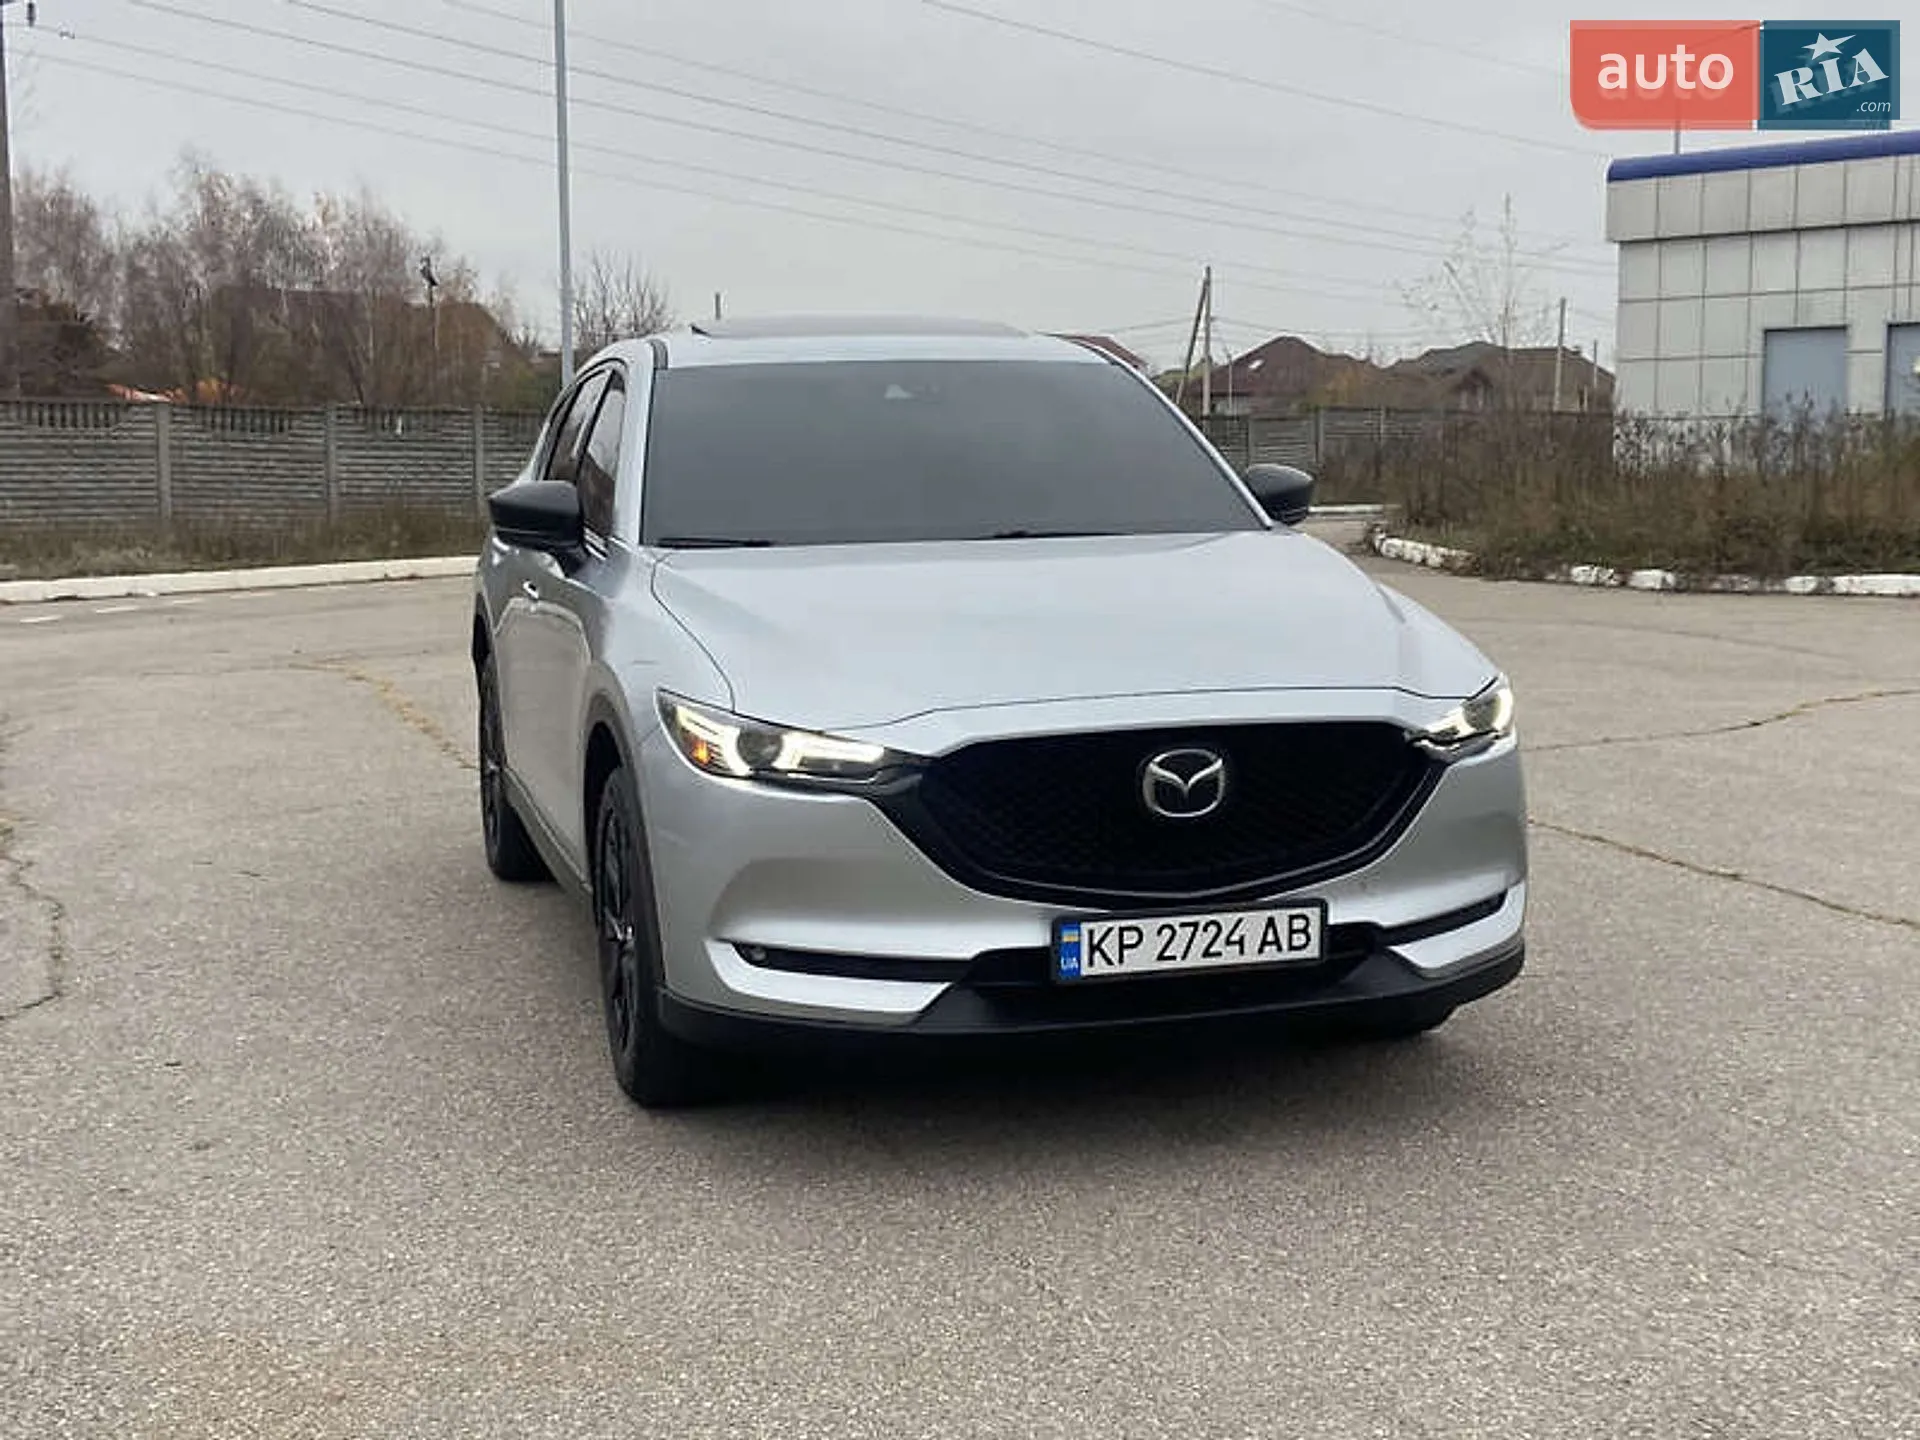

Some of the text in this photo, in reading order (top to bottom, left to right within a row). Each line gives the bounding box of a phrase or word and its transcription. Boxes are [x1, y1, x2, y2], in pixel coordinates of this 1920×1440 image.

[1087, 914, 1312, 967] KP 2724 AB
[1060, 957, 1079, 970] UA
